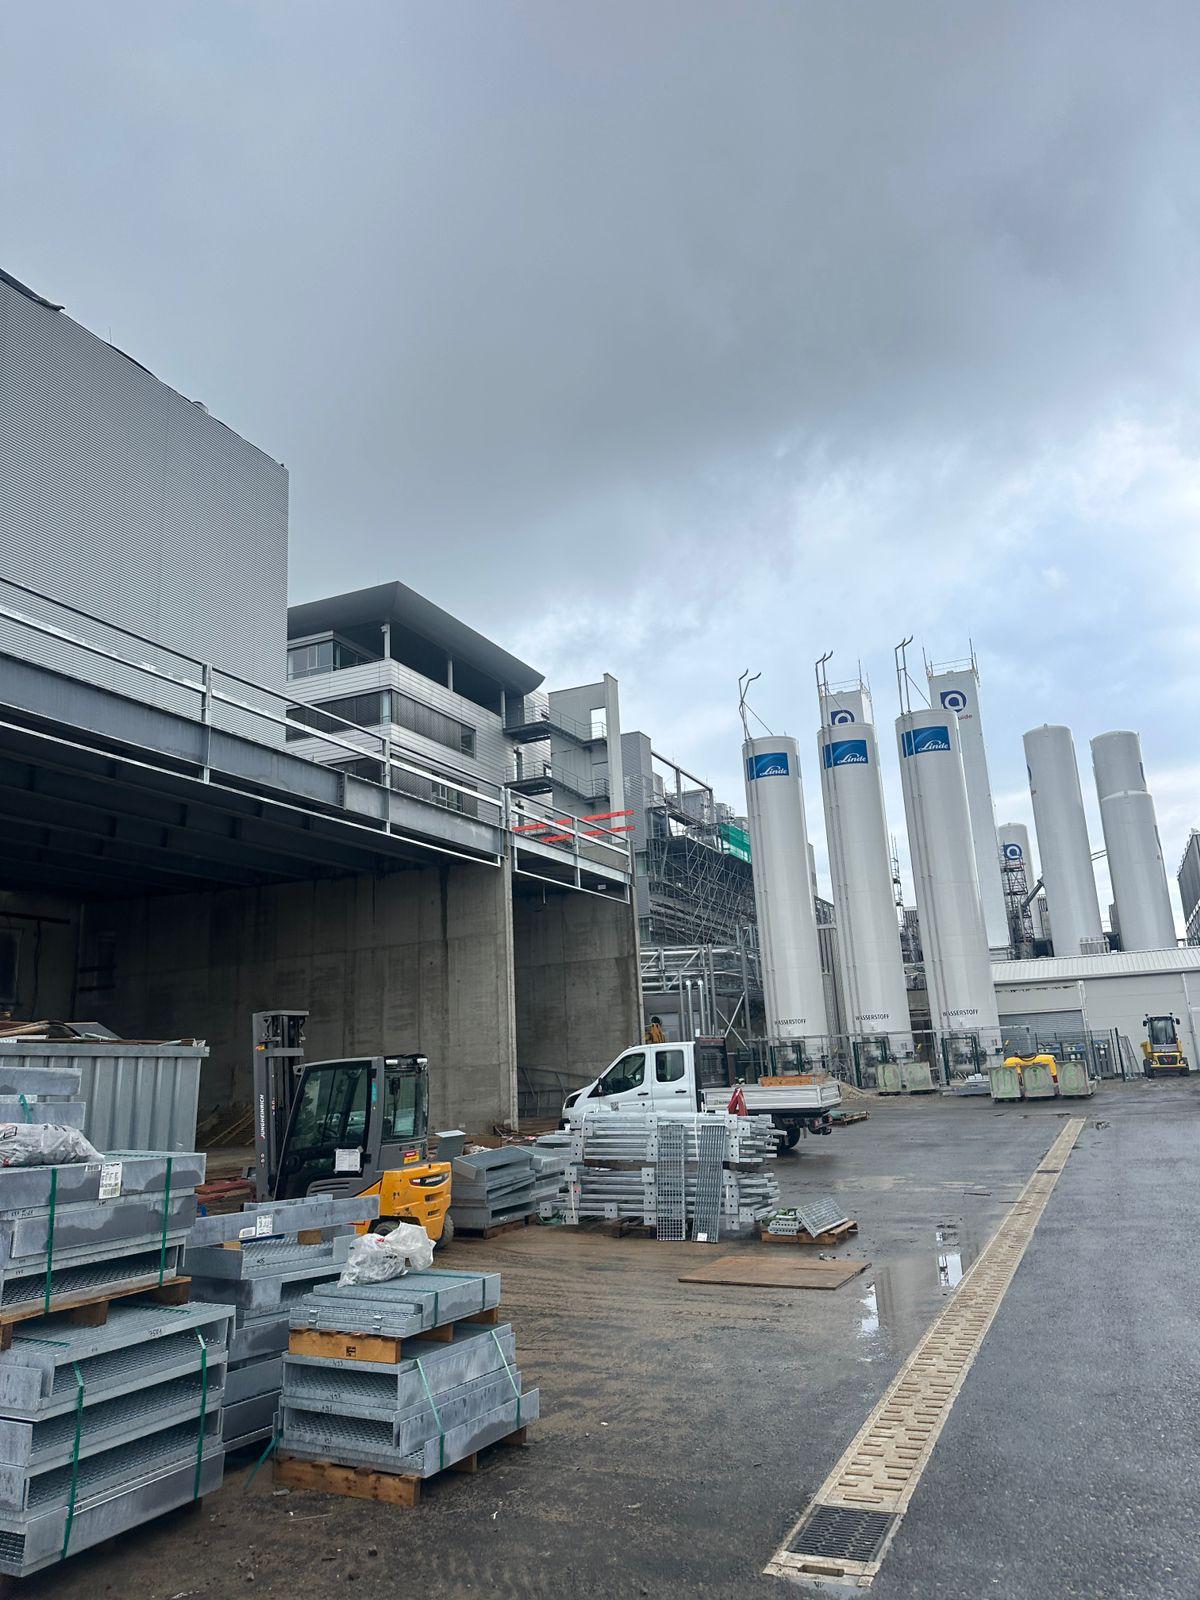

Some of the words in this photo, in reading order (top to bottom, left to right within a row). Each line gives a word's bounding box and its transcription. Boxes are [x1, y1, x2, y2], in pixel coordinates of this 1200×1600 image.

[918, 739, 949, 751] Linde
[837, 752, 867, 764] Linde
[760, 765, 788, 776] Linde
[855, 1013, 890, 1021] WASSERSTOFF
